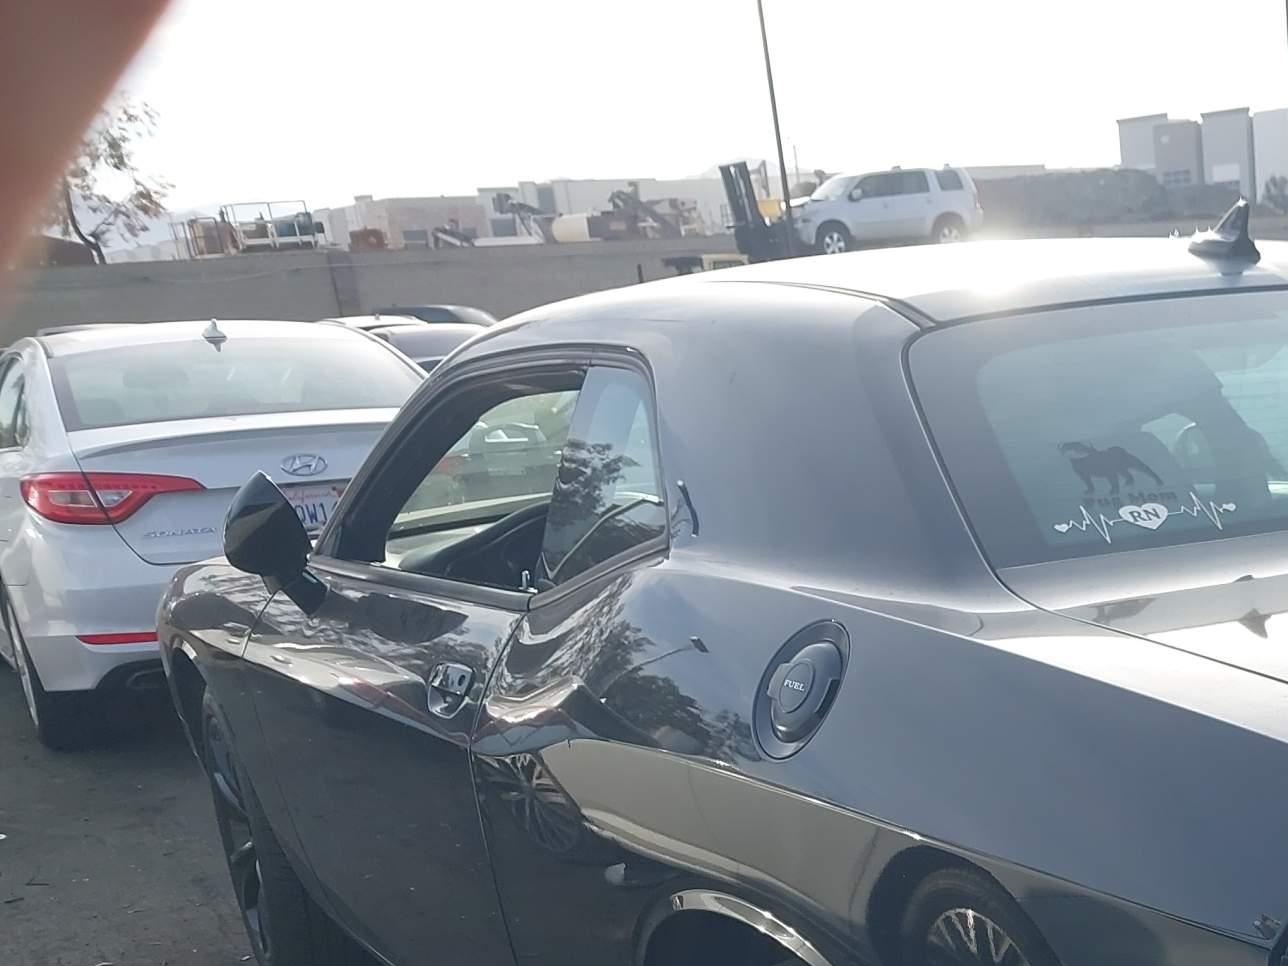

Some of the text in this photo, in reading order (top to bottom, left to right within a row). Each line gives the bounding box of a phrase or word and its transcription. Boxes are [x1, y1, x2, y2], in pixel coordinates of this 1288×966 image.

[1129, 507, 1161, 523] RN
[144, 527, 217, 538] SONATA
[783, 679, 805, 692] FUEL
